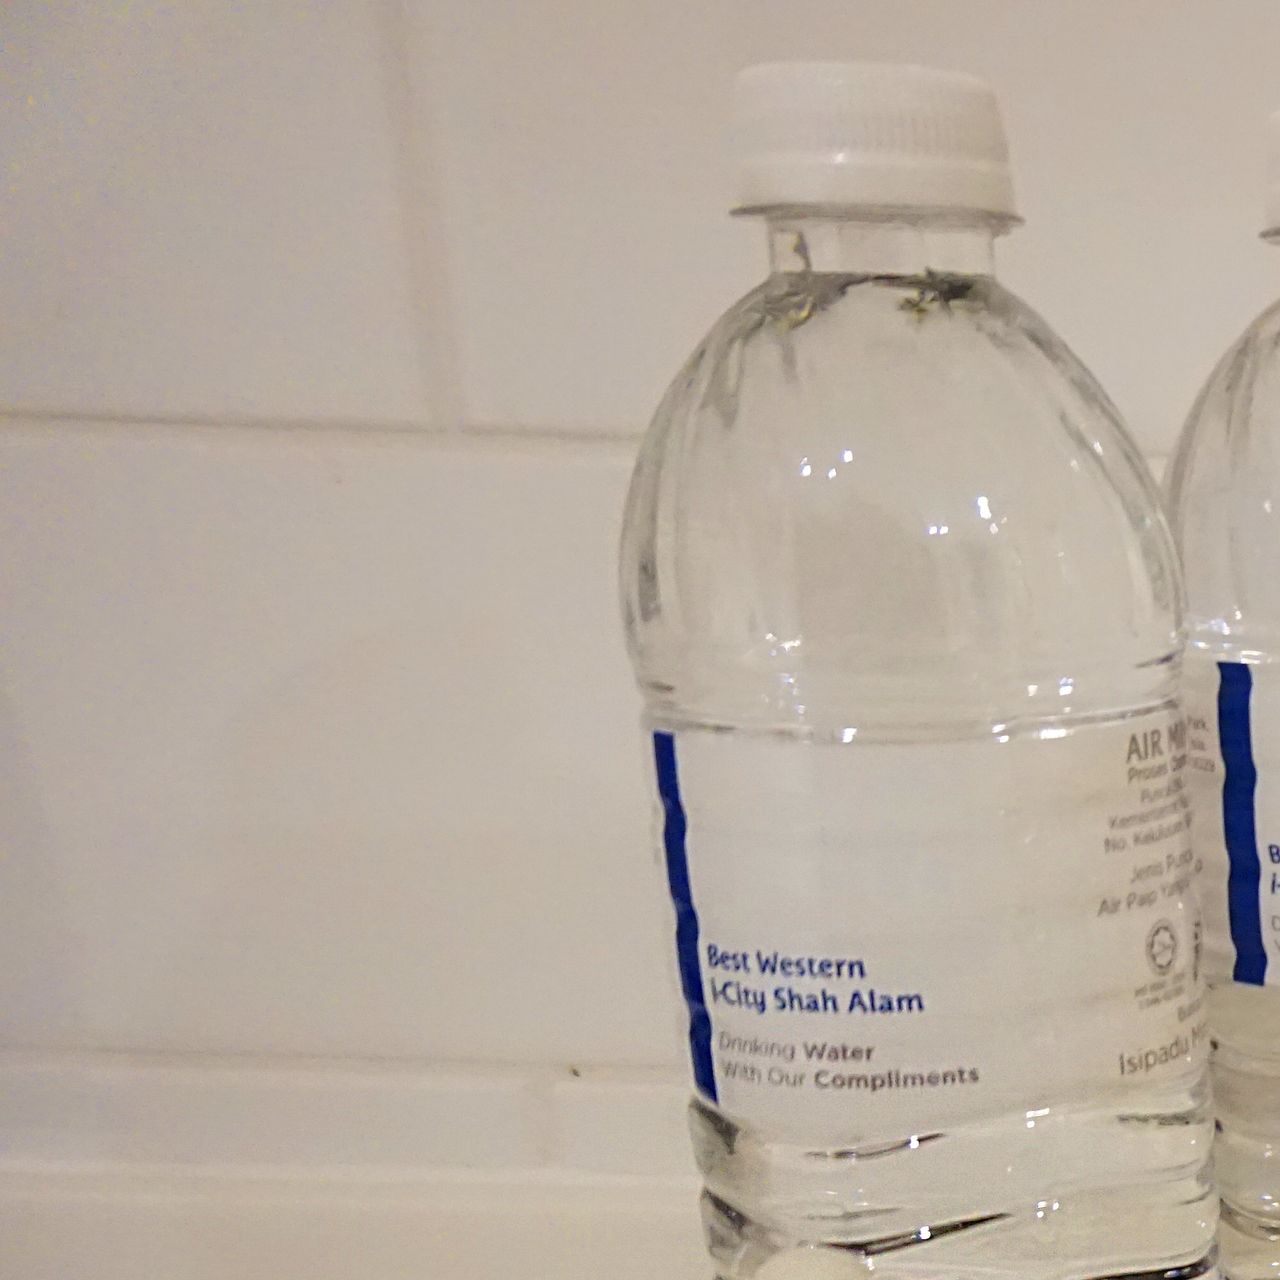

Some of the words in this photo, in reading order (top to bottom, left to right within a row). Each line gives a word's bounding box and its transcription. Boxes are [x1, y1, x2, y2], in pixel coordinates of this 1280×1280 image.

[1126, 729, 1164, 764] AIR
[707, 944, 750, 971] Best
[755, 951, 866, 979] Western
[773, 986, 839, 1013] Shah
[847, 989, 925, 1014] Alam
[717, 1031, 795, 1060] Drinking
[802, 1042, 876, 1060] Water
[1118, 1036, 1191, 1075] Isipadu
[721, 1059, 762, 1082] With
[767, 1066, 806, 1087] Our
[814, 1067, 980, 1092] Compliments
